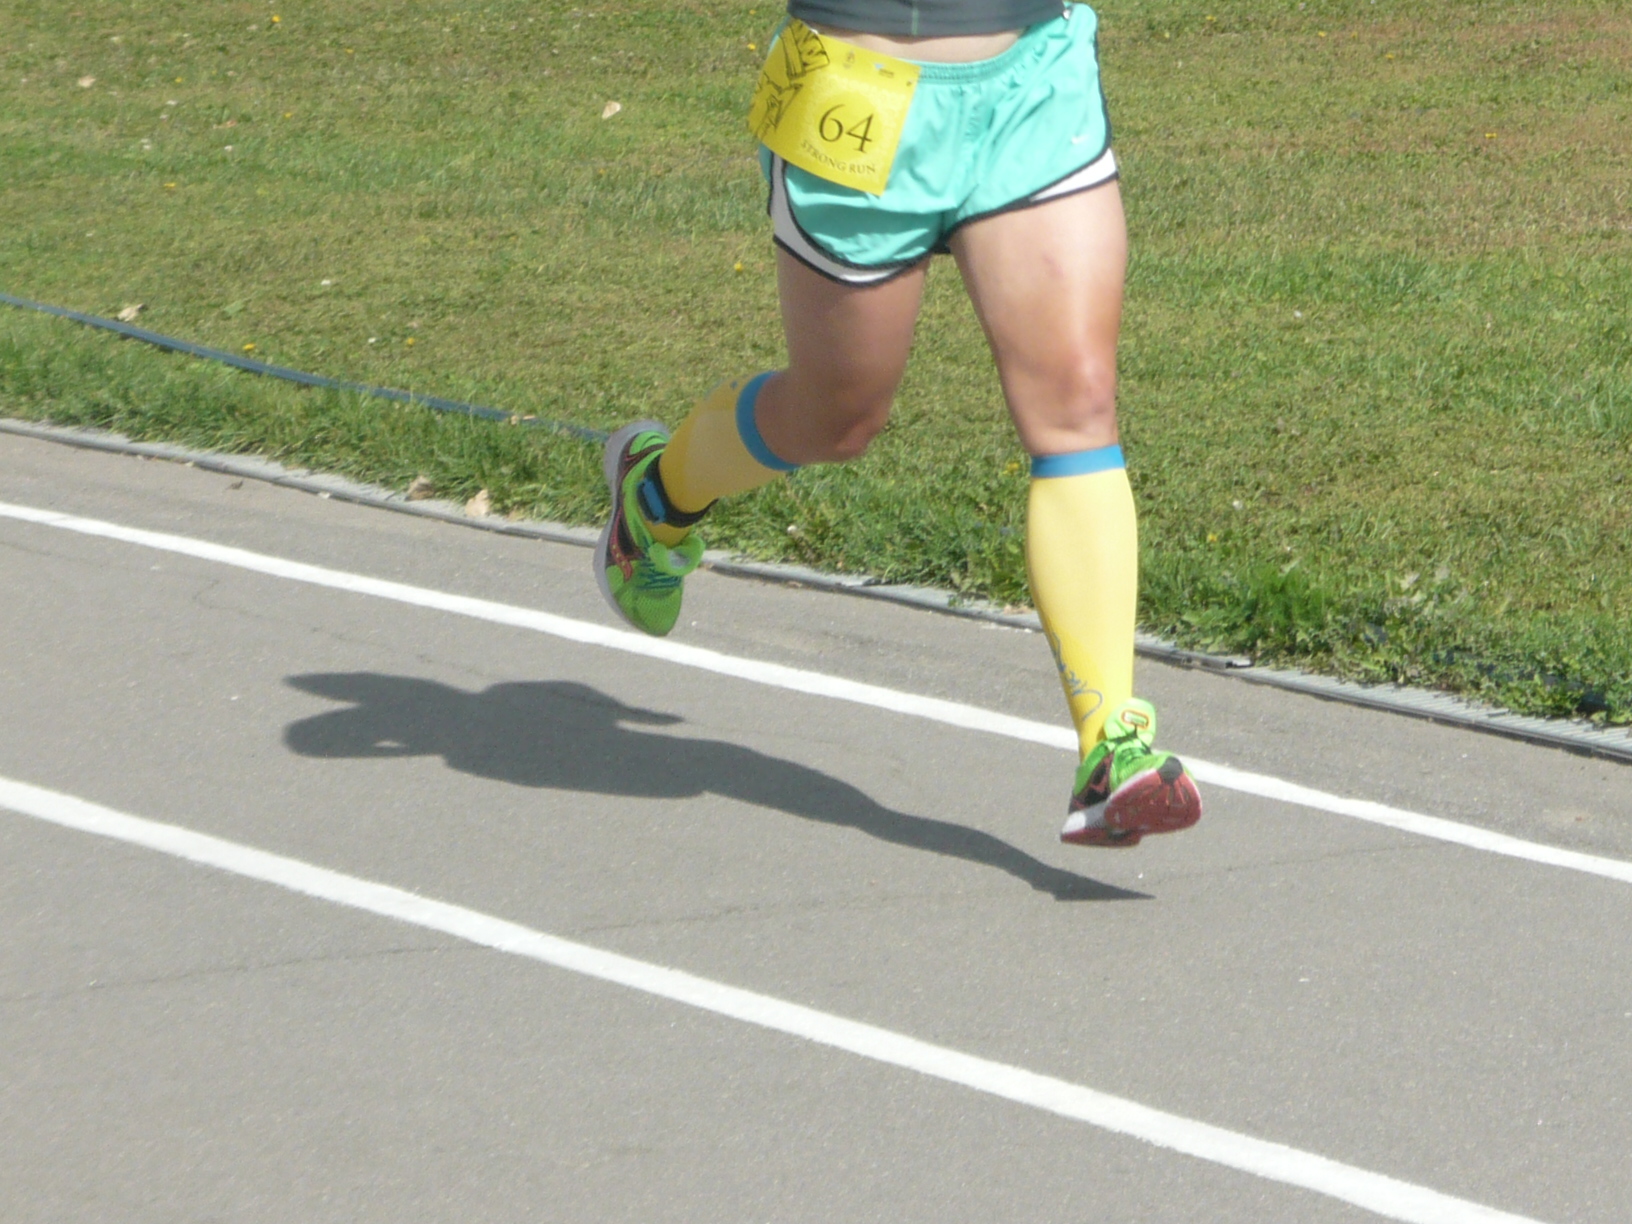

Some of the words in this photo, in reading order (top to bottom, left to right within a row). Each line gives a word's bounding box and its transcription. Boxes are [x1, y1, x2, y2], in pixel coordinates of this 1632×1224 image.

[818, 103, 875, 154] 64
[800, 139, 848, 172] STRONG
[849, 162, 877, 175] RUN
